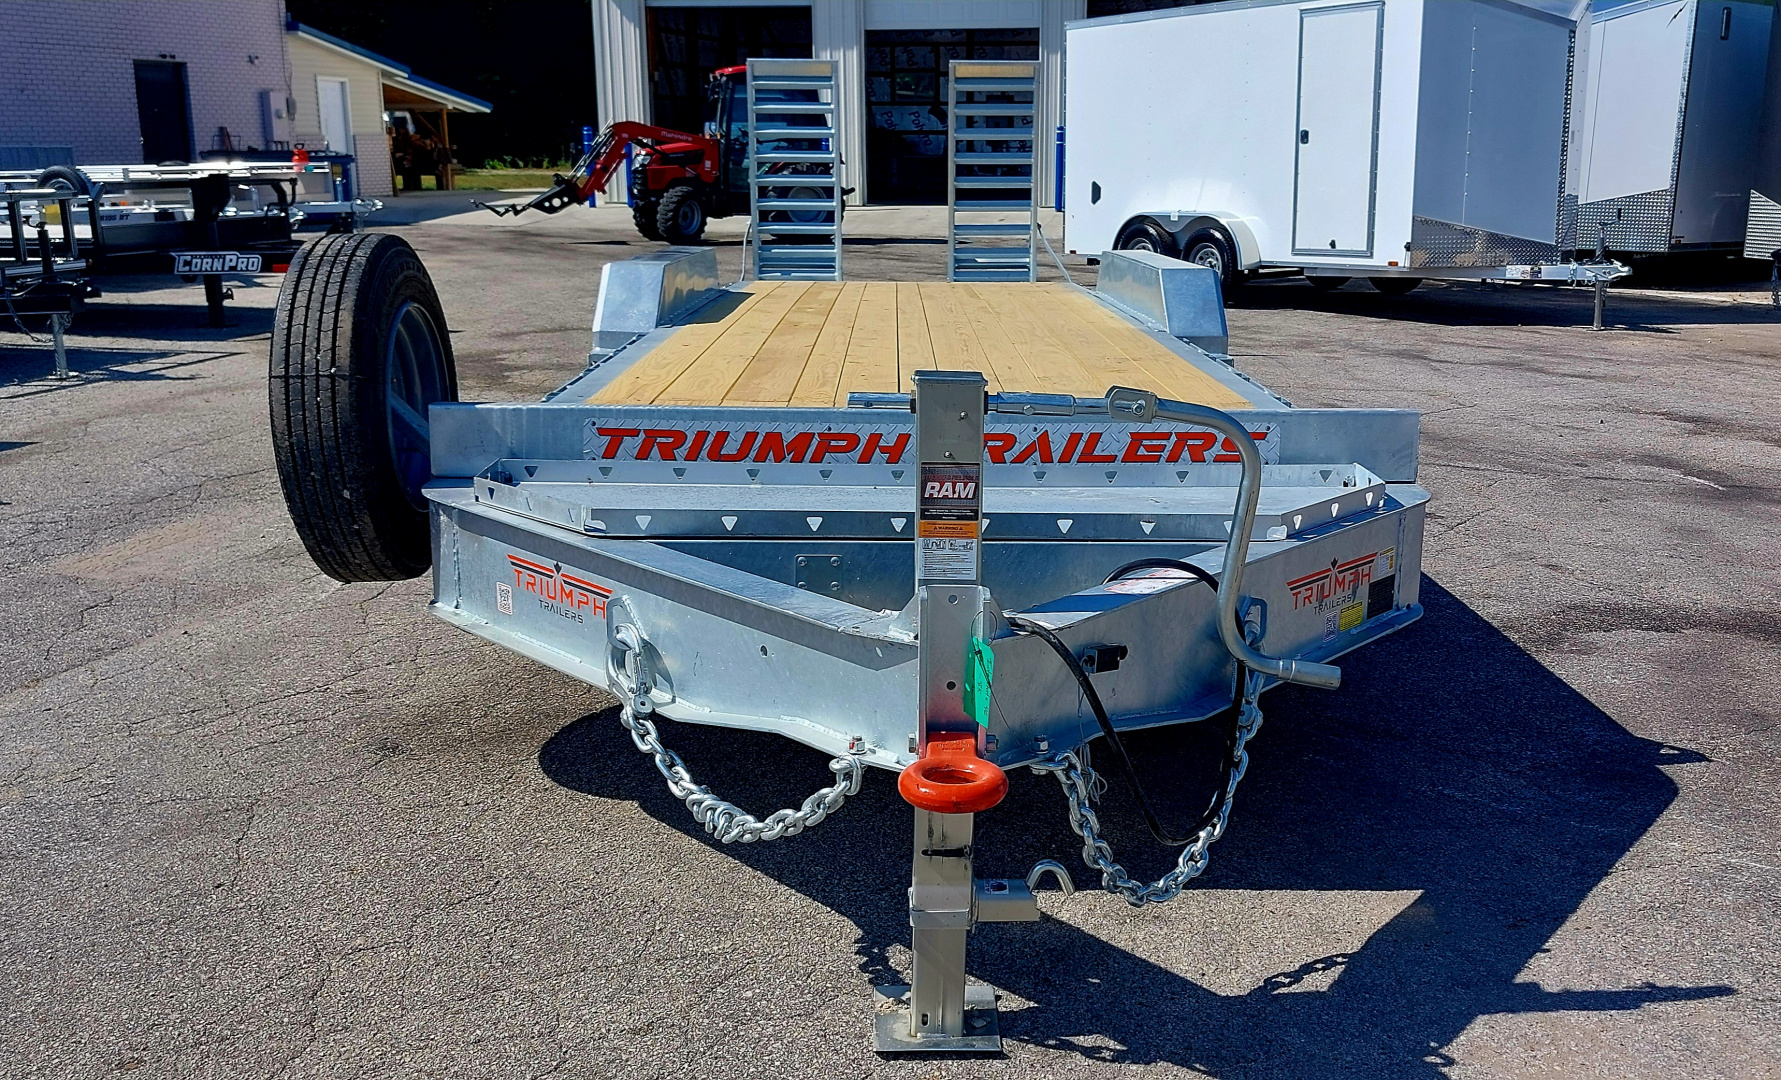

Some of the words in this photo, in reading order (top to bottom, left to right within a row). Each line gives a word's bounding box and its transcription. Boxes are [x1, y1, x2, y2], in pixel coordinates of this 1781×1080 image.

[597, 428, 912, 464] TRIUMPH
[984, 430, 1268, 464] RAILERS
[924, 482, 976, 498] RAM
[513, 568, 607, 620] TRIUMPH
[1292, 566, 1373, 611] TRIUMPH
[538, 599, 584, 624] TRAILERS
[1313, 594, 1352, 616] TRAILERS
